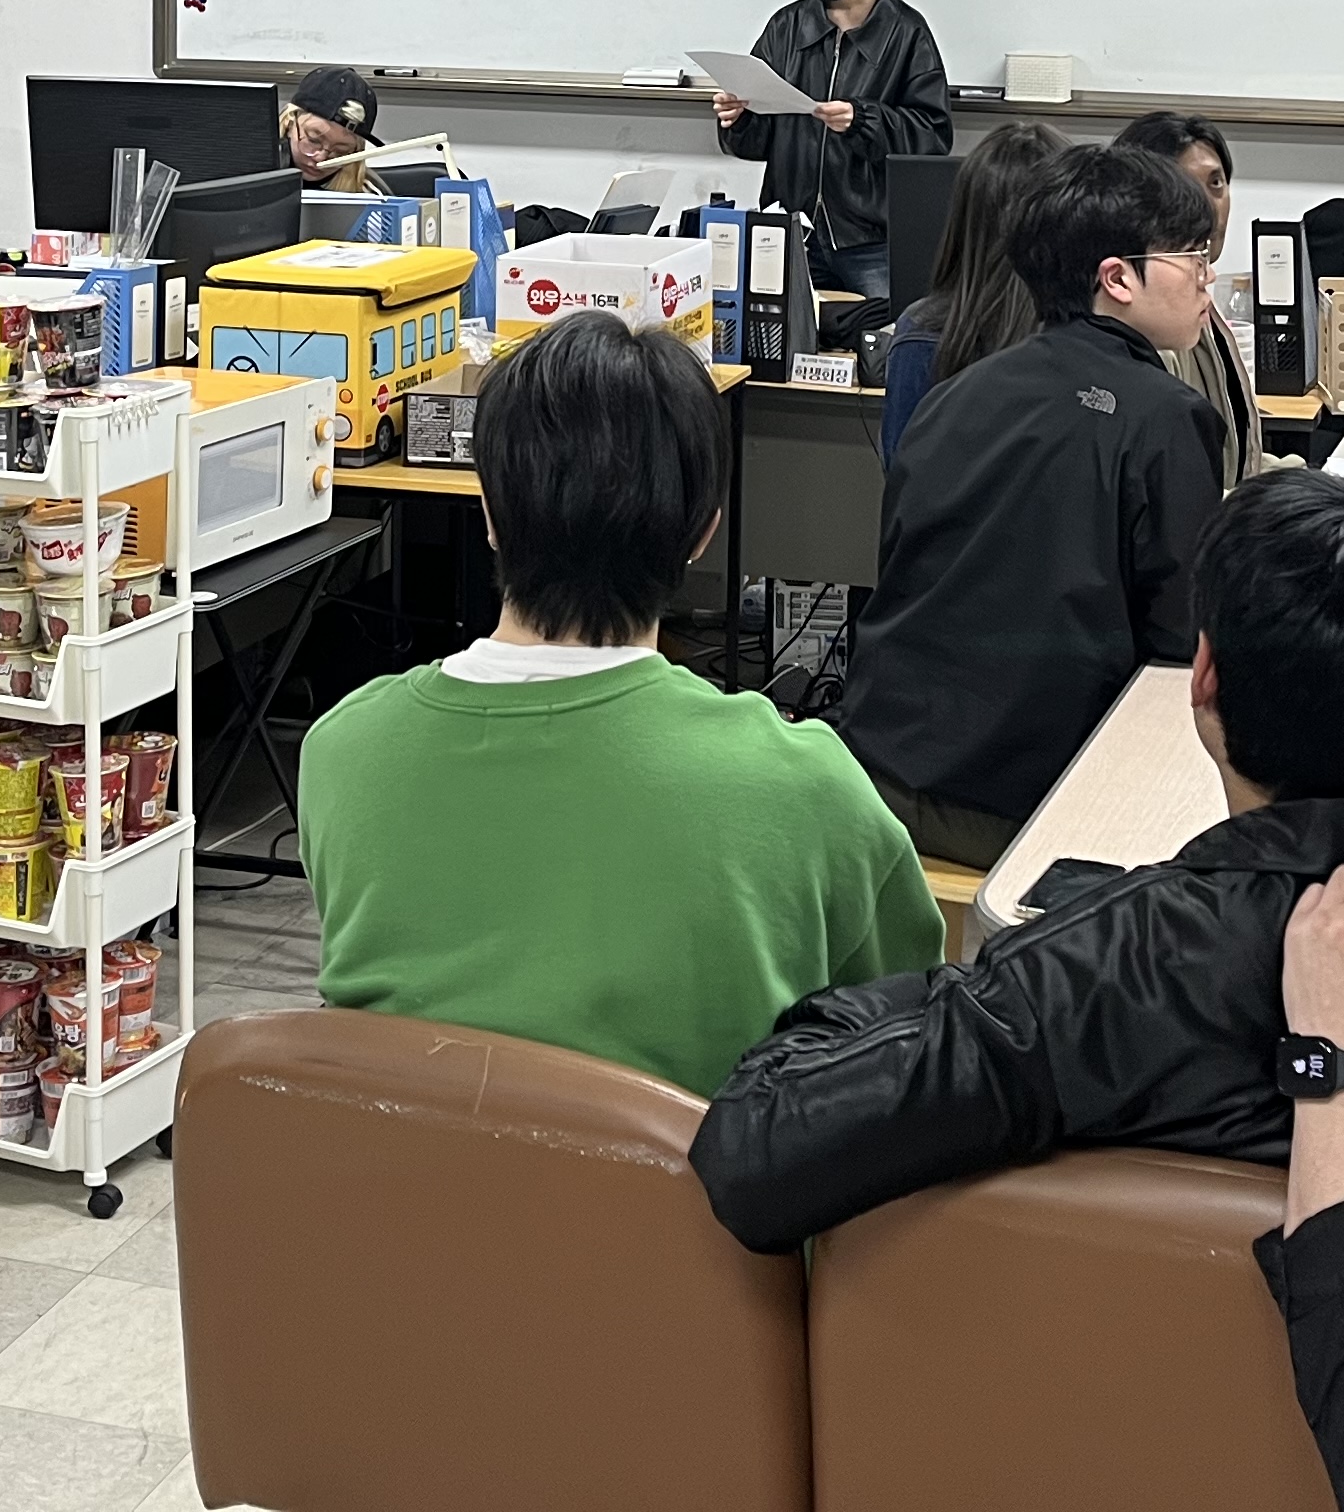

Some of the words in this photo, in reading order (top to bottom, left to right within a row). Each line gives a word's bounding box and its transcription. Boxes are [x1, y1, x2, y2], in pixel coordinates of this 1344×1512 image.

[590, 292, 620, 309] 16팩
[395, 373, 419, 393] SCHOOL
[420, 368, 433, 385] BUS
[53, 1022, 83, 1044] 우탕
